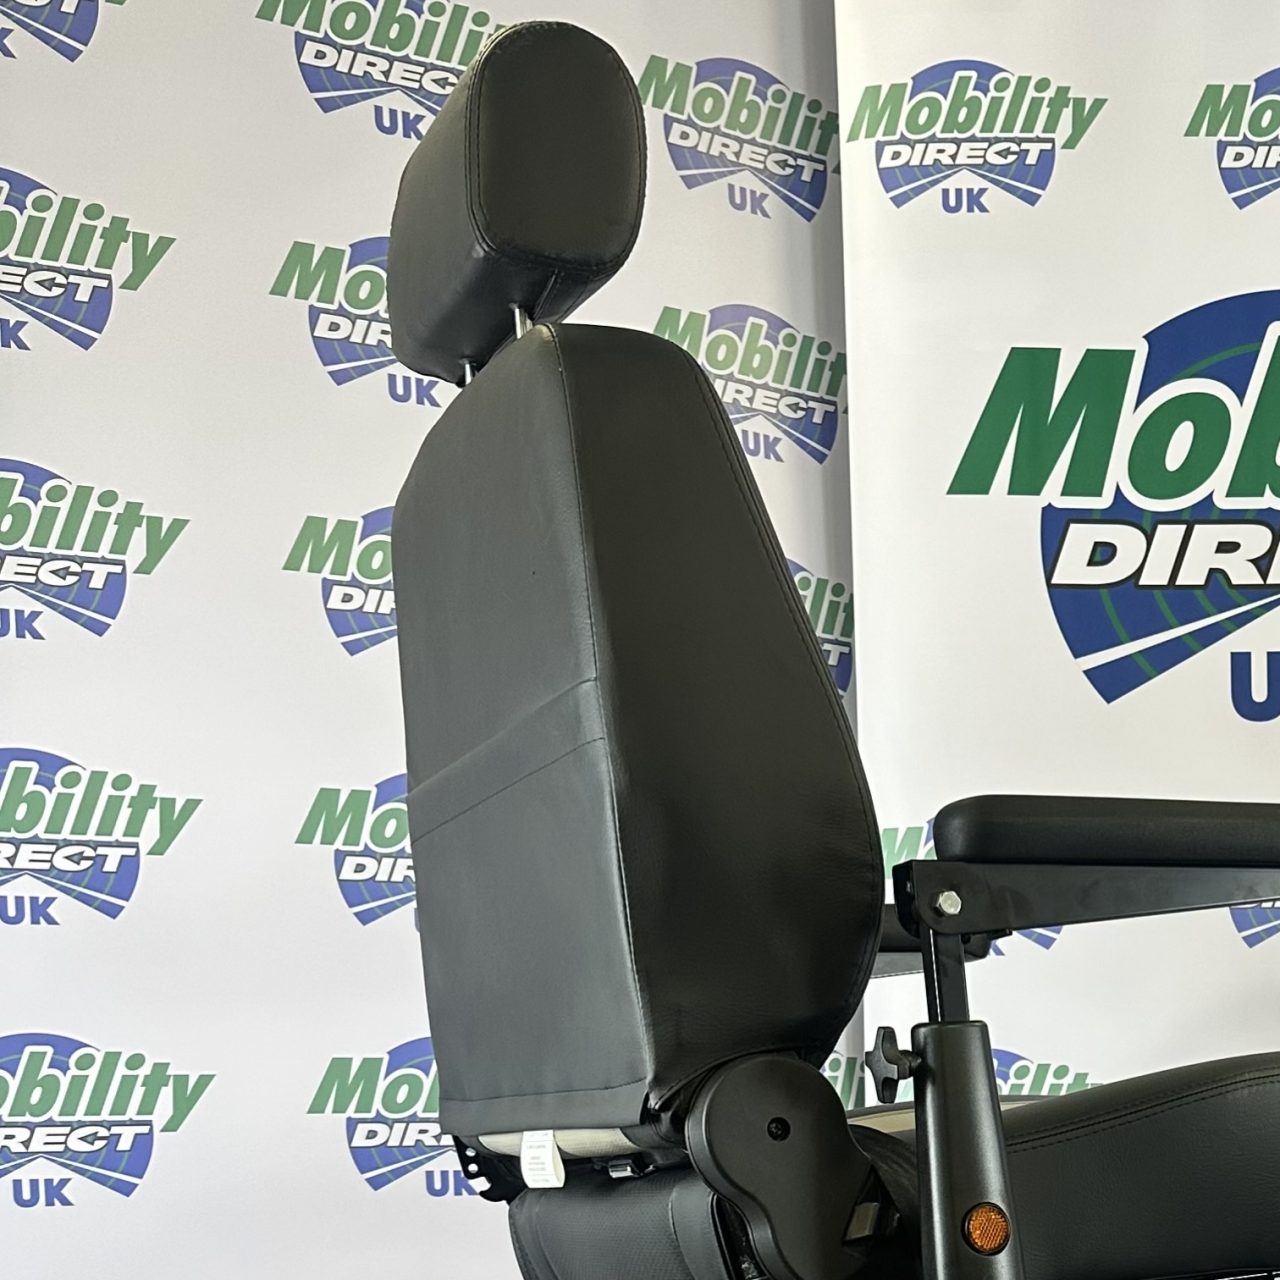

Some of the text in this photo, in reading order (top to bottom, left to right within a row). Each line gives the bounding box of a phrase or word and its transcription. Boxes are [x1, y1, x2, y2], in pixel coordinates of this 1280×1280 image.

[298, 40, 461, 95] DIREC
[373, 104, 426, 141] UK
[636, 56, 845, 160] Mobilit
[846, 74, 1109, 150] Mobility
[667, 122, 825, 183] DIRECT
[878, 141, 1055, 169] DIRECT
[727, 182, 772, 220] UK
[941, 187, 990, 214] UK
[0, 317, 32, 352] K
[652, 304, 849, 402] Mobilit
[387, 373, 442, 408] UK
[712, 378, 835, 426] IRECT
[741, 429, 785, 463] UK
[0, 477, 189, 575] bility
[0, 555, 123, 588] ECT
[0, 767, 201, 856] bility
[0, 1051, 216, 1133] bility
[0, 1125, 151, 1153] RECT
[12, 1177, 75, 1209] UK
[425, 1170, 481, 1197] UK
